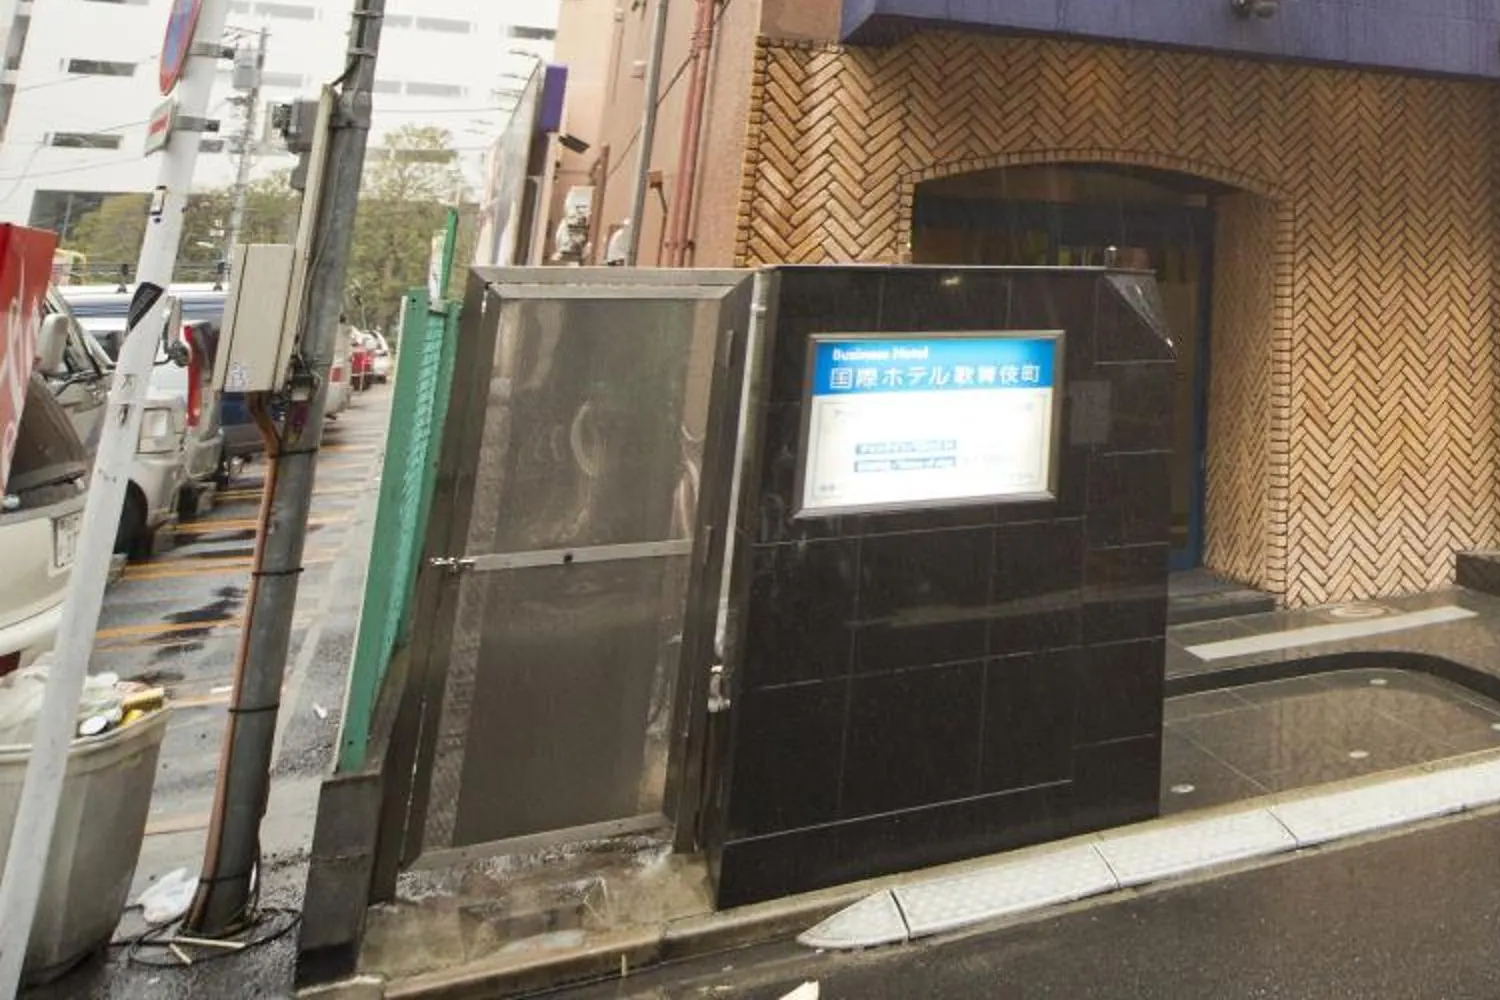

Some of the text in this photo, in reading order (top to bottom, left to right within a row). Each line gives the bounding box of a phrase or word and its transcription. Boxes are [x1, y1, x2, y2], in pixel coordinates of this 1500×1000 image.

[830, 365, 1041, 389] 国際ホテル歌舞伎町
